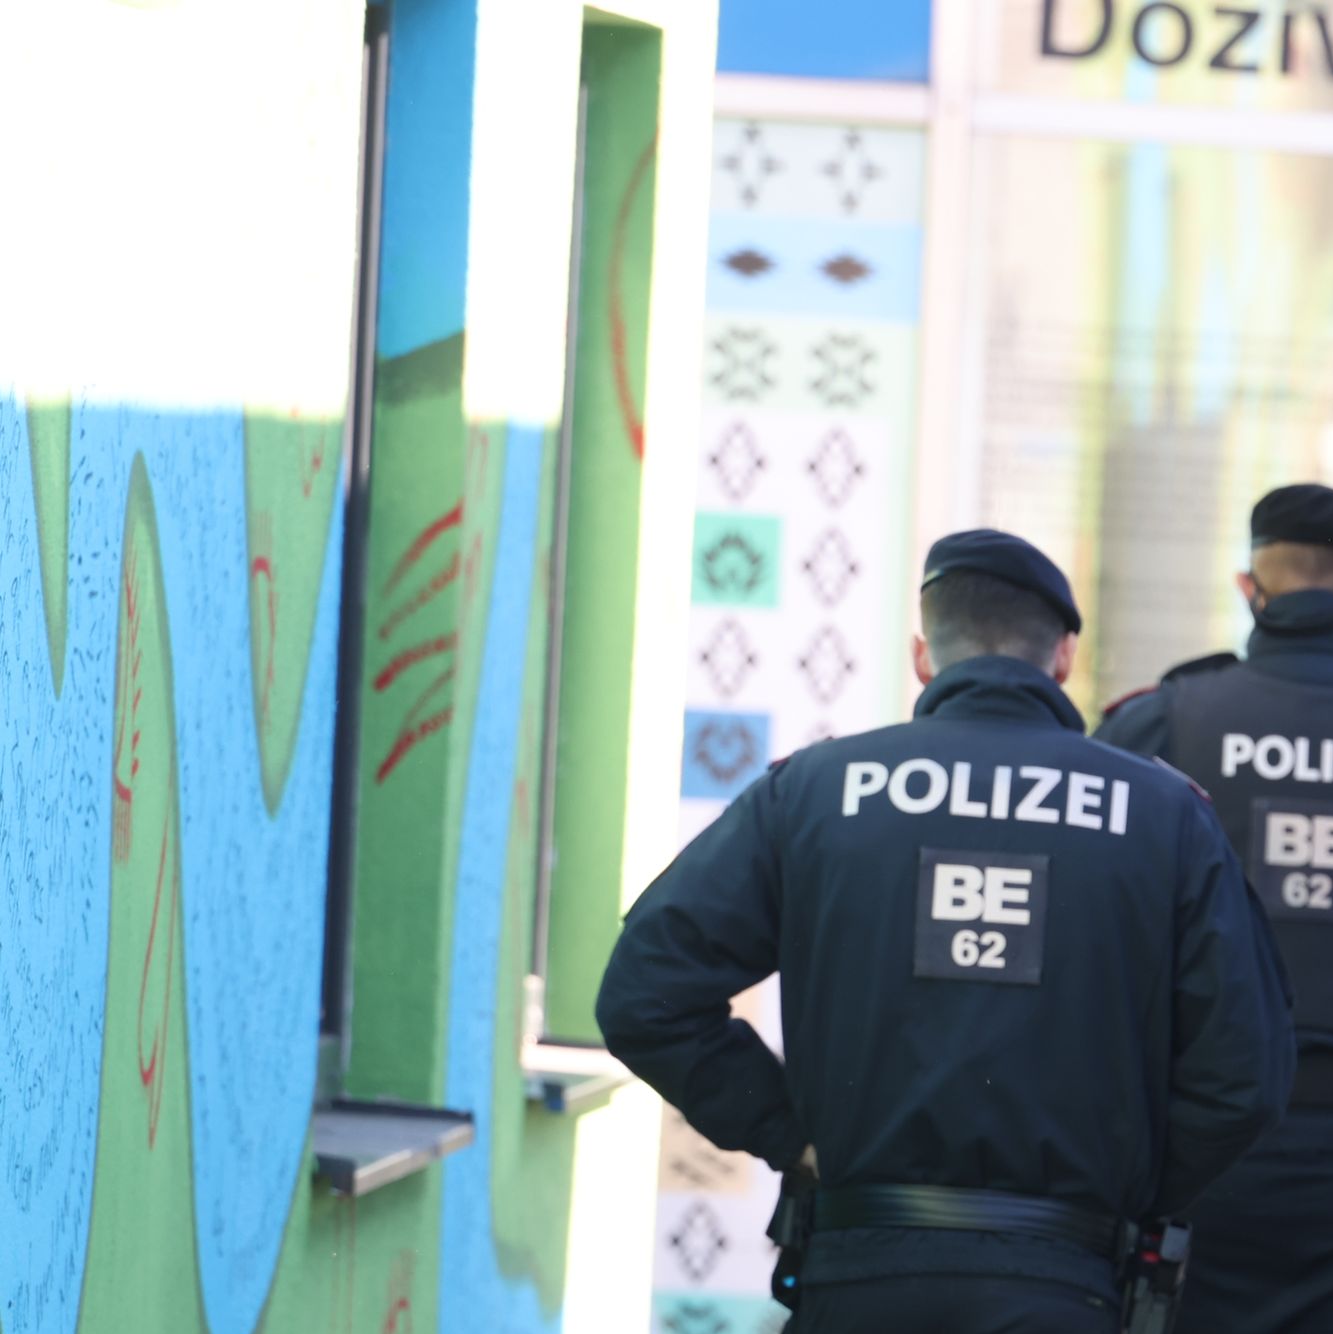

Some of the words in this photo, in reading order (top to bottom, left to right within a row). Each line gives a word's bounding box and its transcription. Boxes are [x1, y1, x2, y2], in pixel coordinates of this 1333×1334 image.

[842, 758, 1131, 835] POLIZEI
[931, 863, 1033, 925] BE
[1283, 874, 1333, 910] 62
[951, 931, 1007, 969] 62
